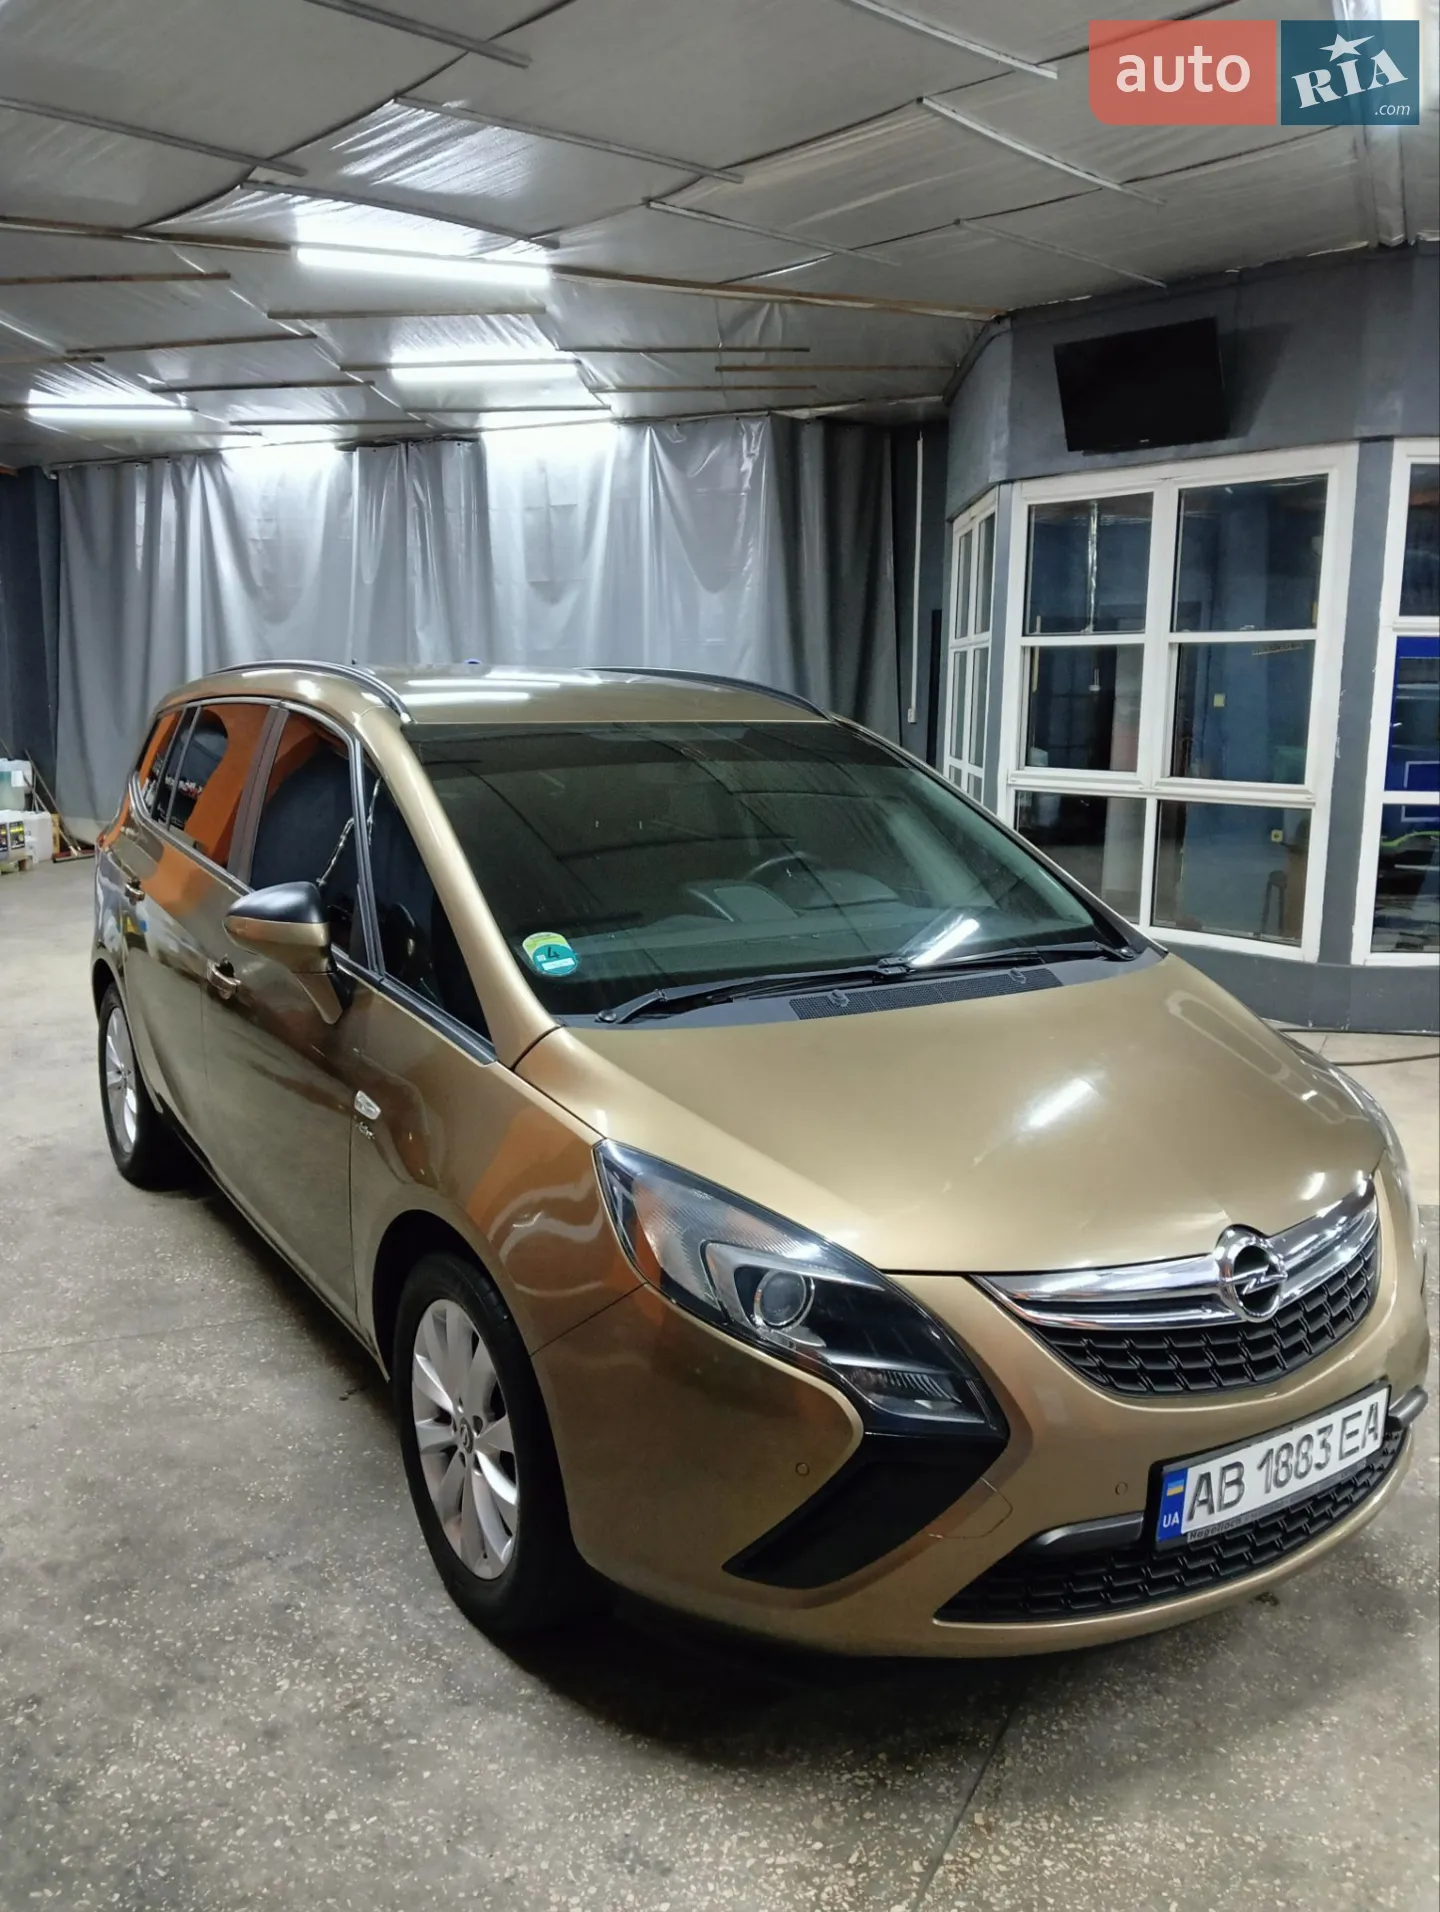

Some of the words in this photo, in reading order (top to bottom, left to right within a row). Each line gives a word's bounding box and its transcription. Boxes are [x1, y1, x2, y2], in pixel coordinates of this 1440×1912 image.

[547, 946, 560, 959] 4
[1186, 1461, 1245, 1522] AB
[1257, 1423, 1333, 1494] 1883
[1338, 1402, 1379, 1461] EA
[1163, 1511, 1180, 1528] UA
